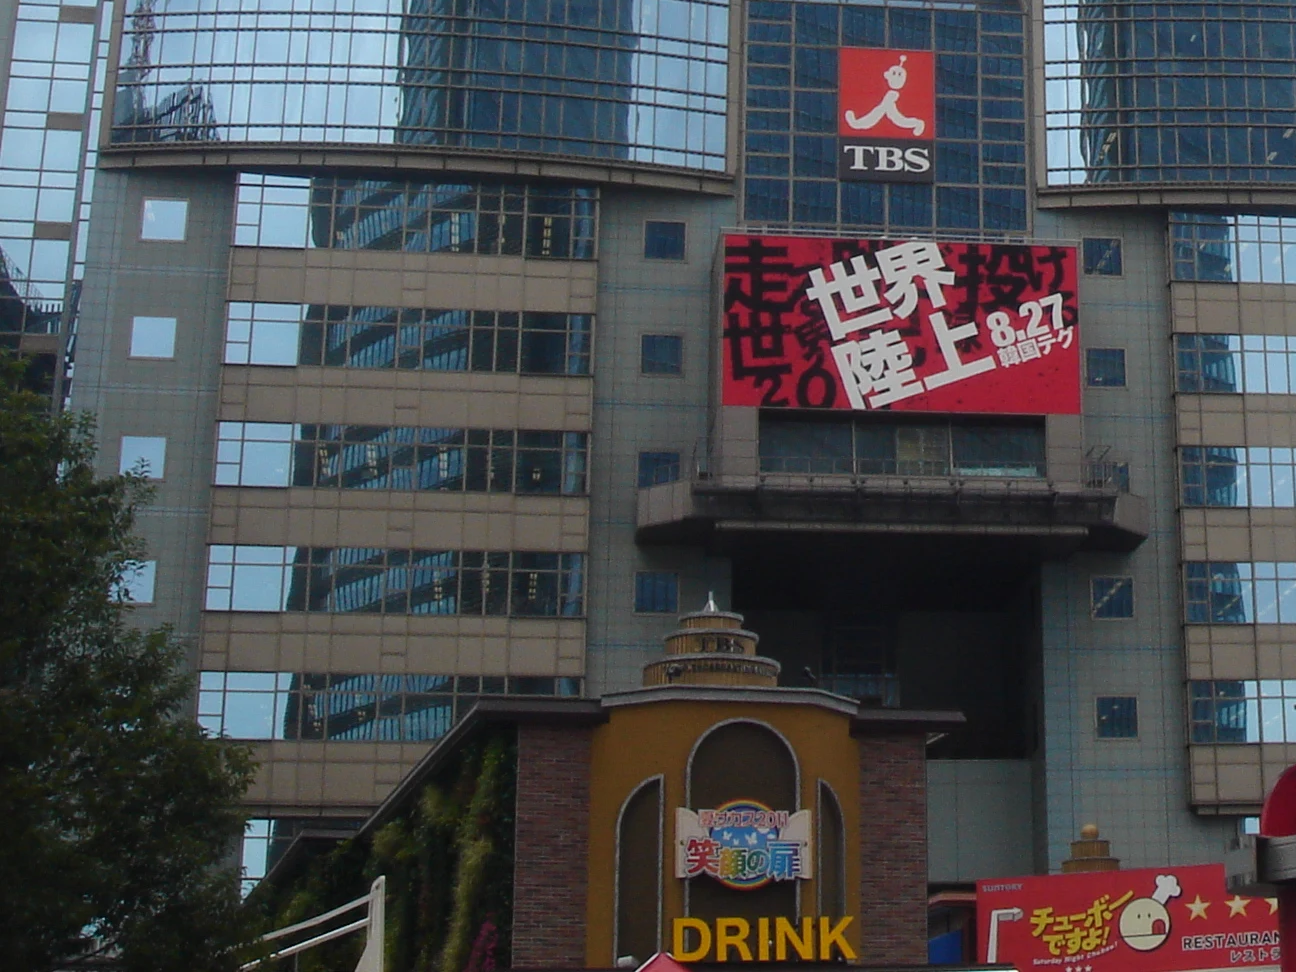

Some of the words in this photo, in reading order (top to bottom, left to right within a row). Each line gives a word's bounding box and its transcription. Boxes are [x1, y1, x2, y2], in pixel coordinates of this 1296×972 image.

[844, 145, 930, 173] TBS
[806, 241, 956, 342] 世界
[985, 292, 1065, 348] 8.27
[830, 312, 997, 410] 陸上
[997, 327, 1075, 370] 韓国テグ
[685, 838, 802, 881] 笑顔の扉
[673, 915, 858, 962] DRINK
